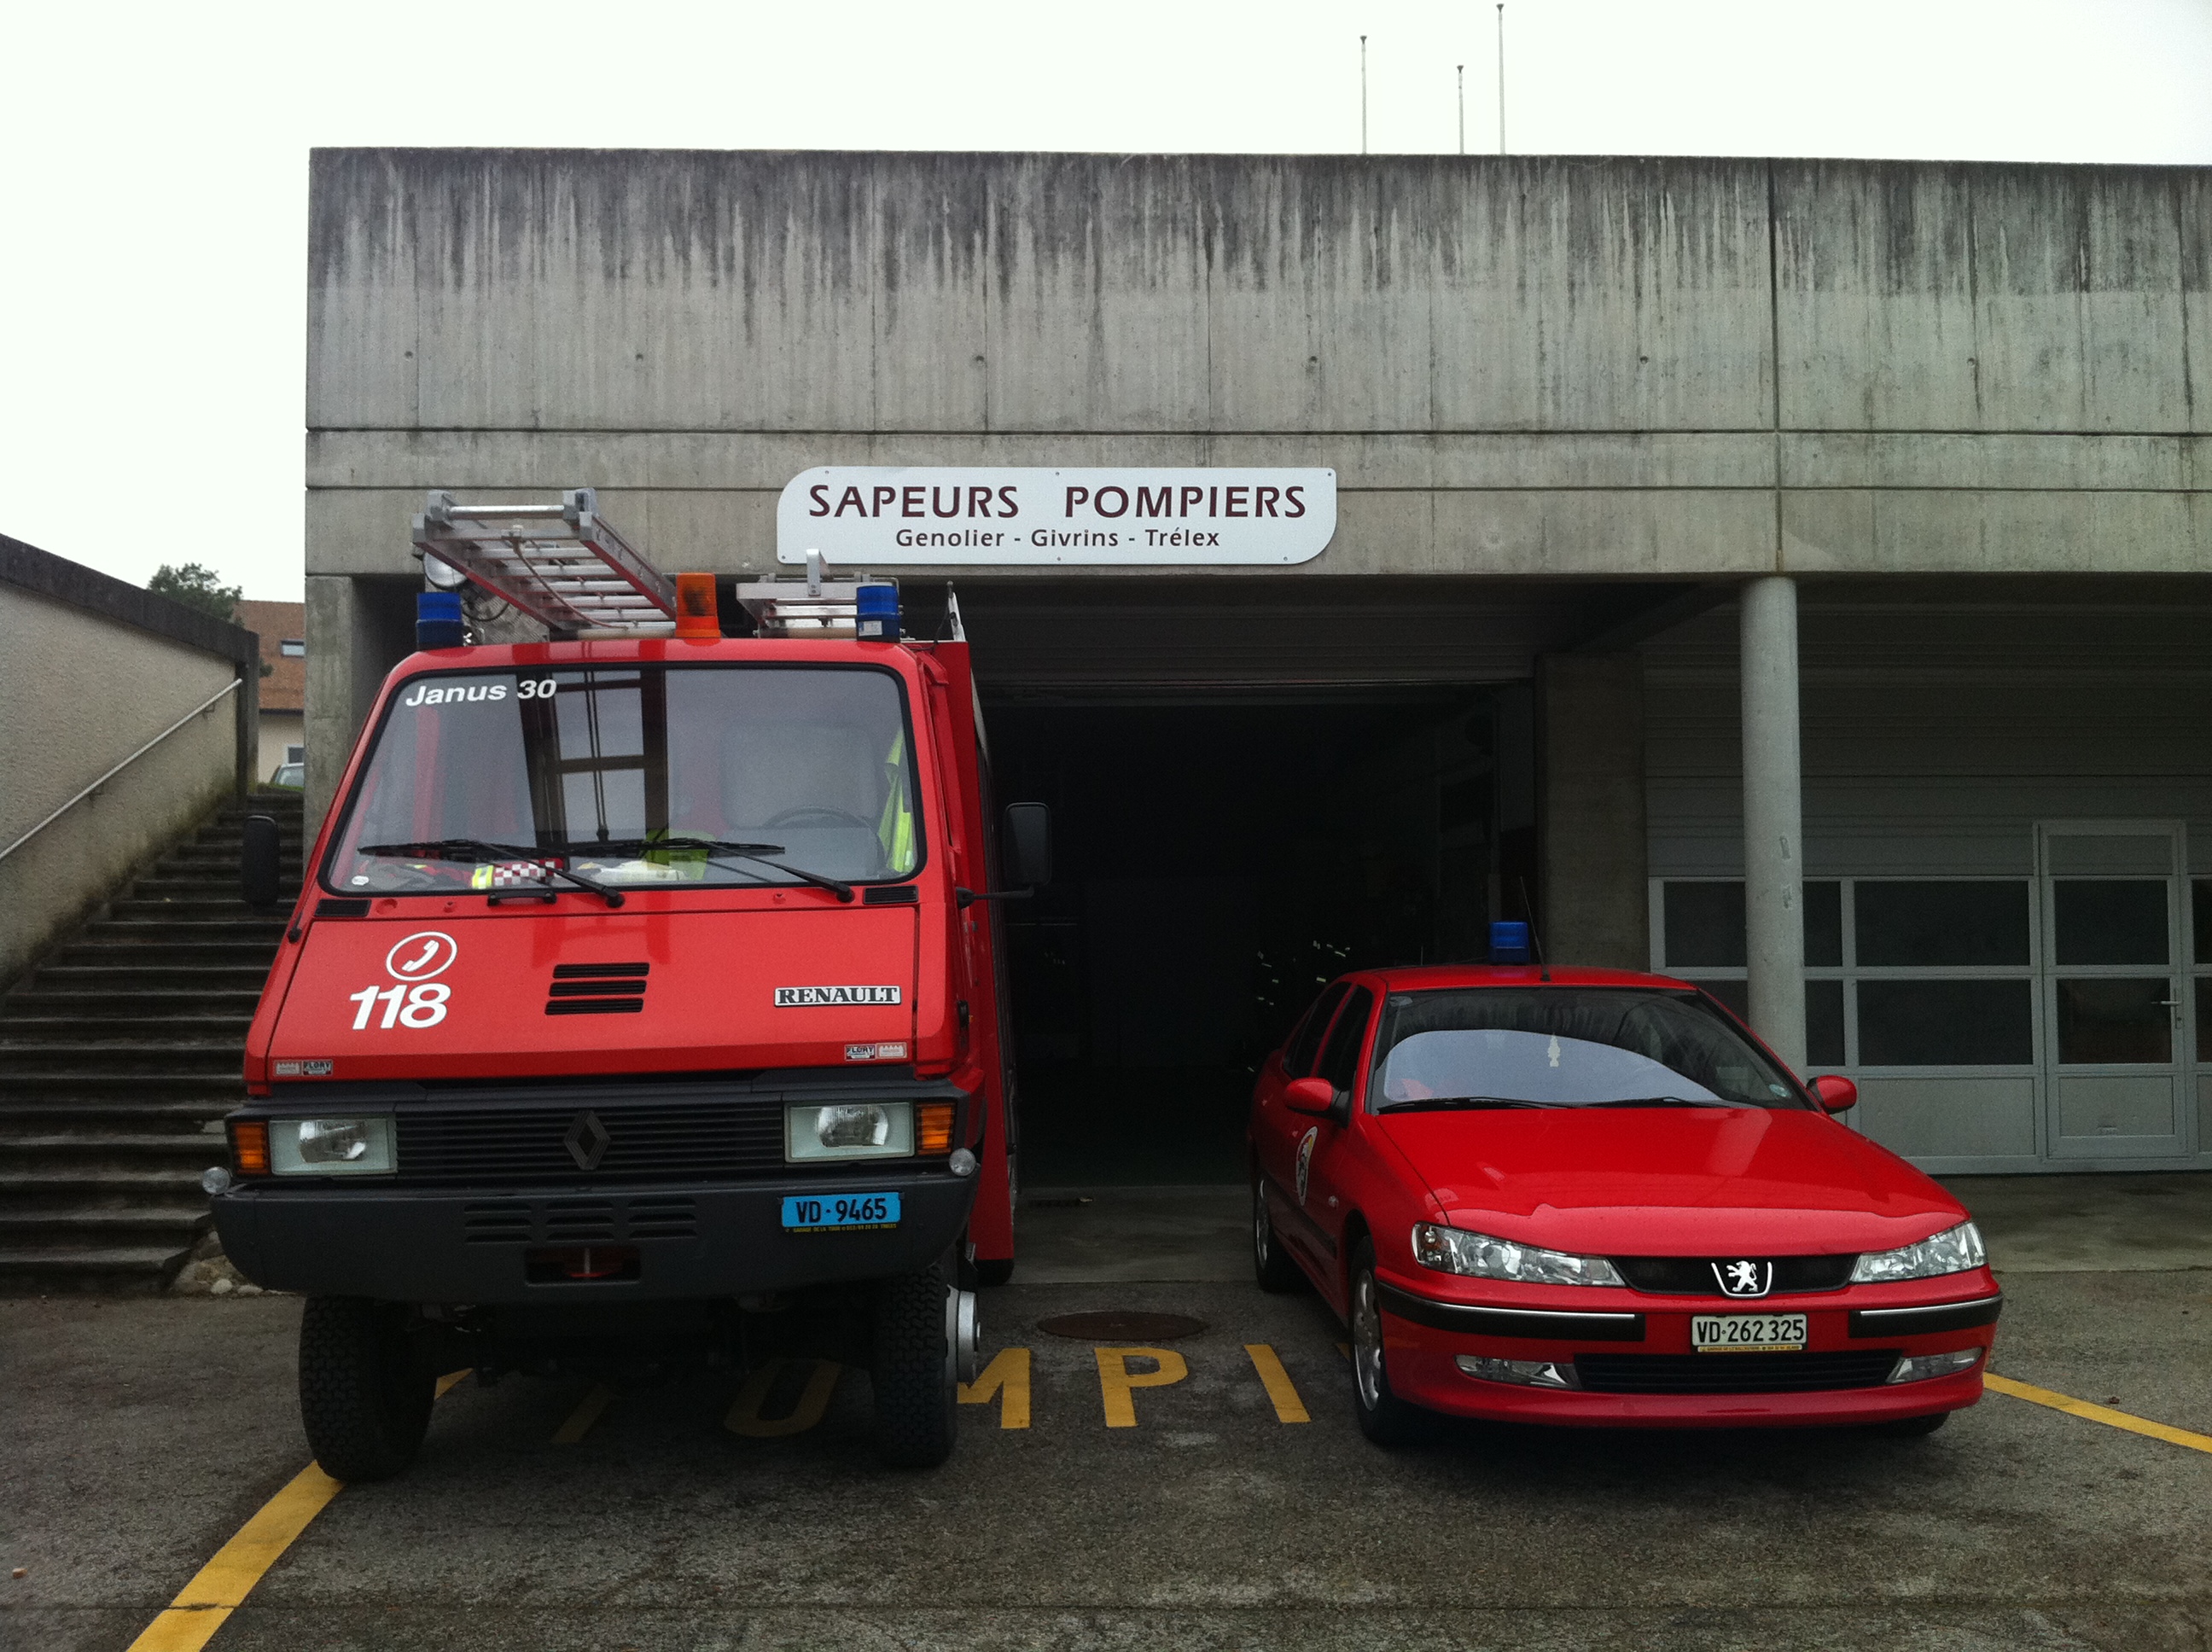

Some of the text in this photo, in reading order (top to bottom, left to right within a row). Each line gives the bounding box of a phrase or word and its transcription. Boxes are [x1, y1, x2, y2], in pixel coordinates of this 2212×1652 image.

[809, 484, 1306, 518] SAPEURS POMPIERS
[896, 529, 1004, 547] Genolier
[1031, 528, 1119, 547] Givrins
[1145, 526, 1220, 547] Trélex
[405, 679, 557, 707] Janus 30
[349, 982, 452, 1030] 118
[777, 986, 898, 1004] RENAULT
